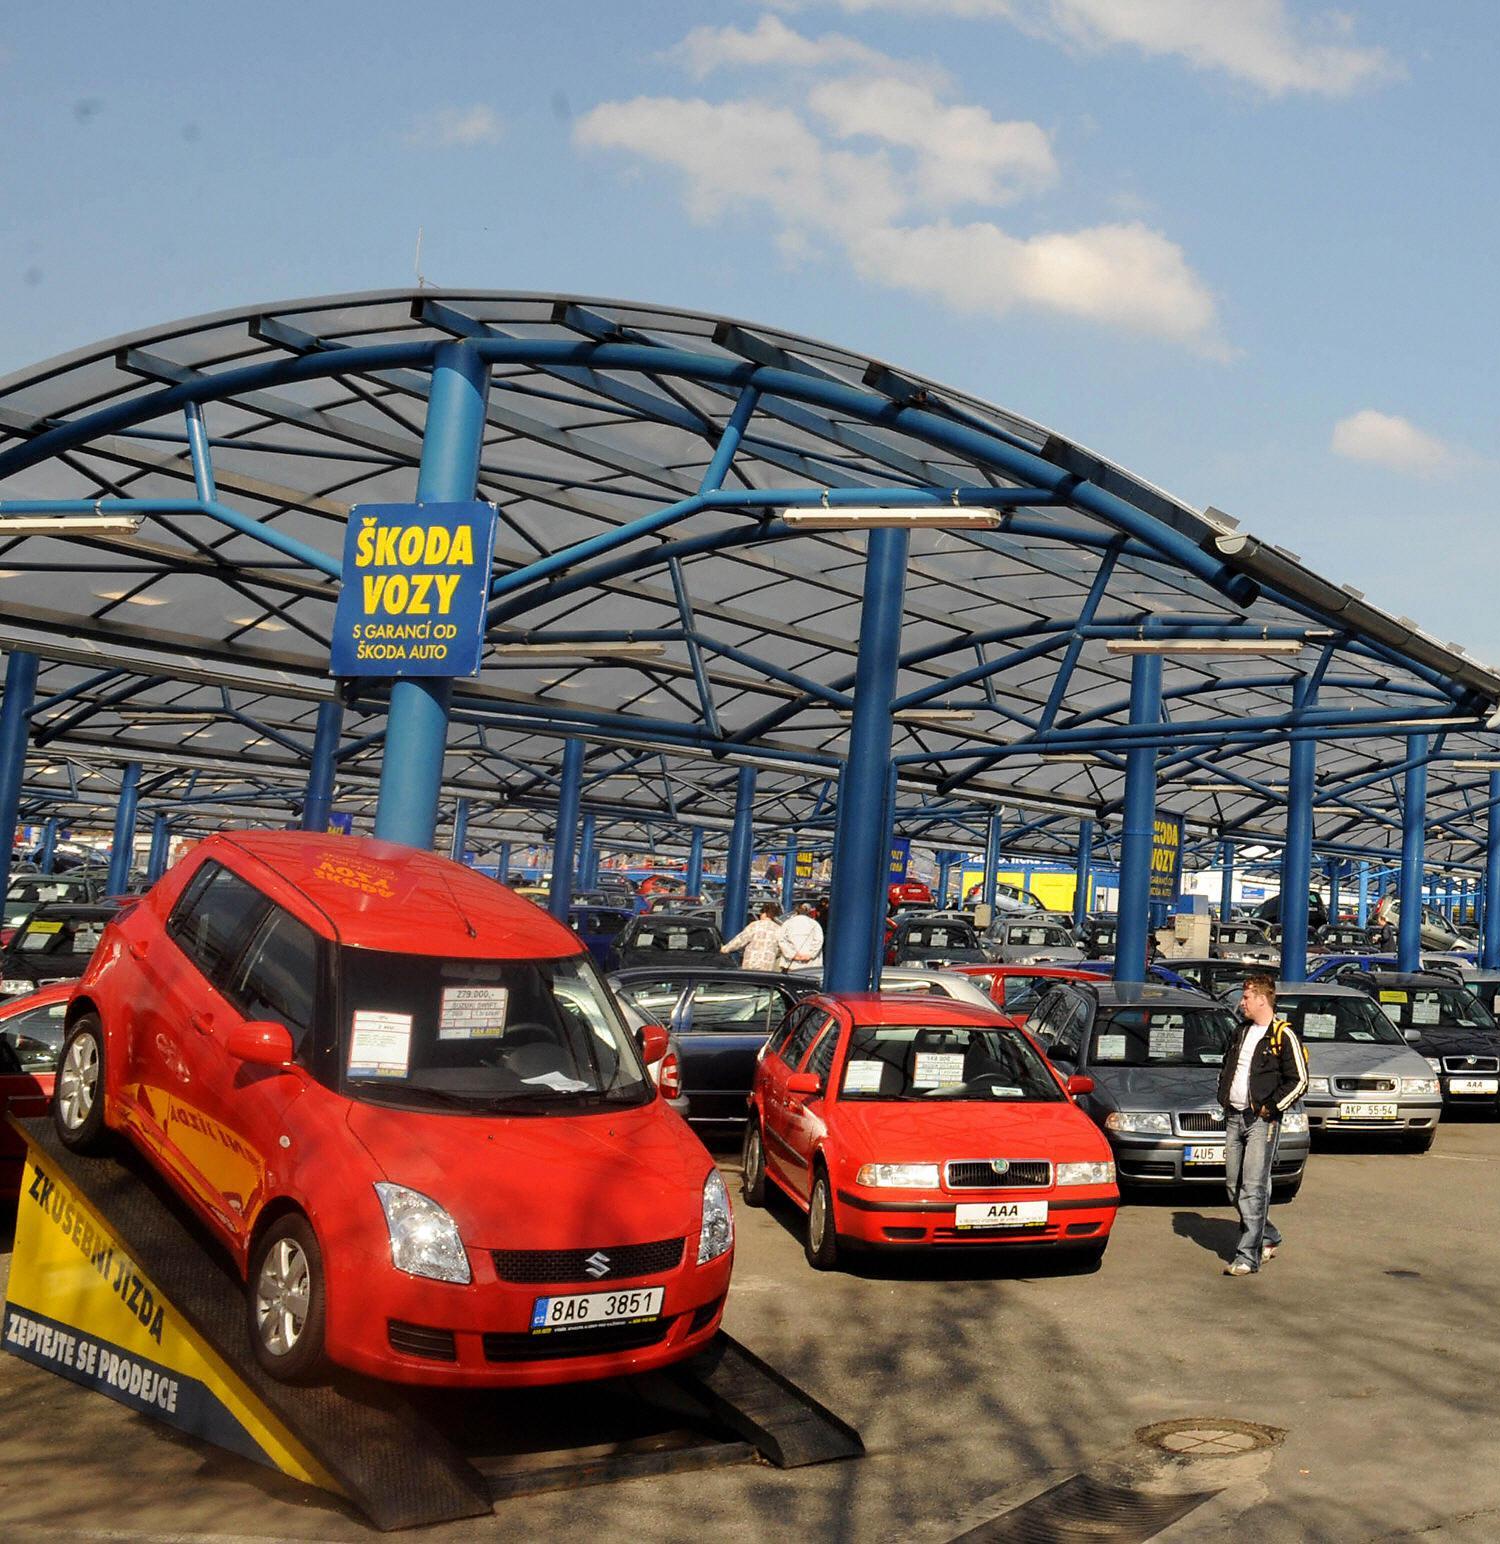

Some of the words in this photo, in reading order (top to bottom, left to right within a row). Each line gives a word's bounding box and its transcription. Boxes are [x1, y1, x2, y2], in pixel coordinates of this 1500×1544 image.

[356, 517, 474, 567] ŠKODA
[363, 574, 461, 615] VOZY
[352, 624, 362, 639] S
[364, 621, 432, 639] GARANCÍ
[433, 624, 457, 639] OD
[357, 640, 406, 660] ŠKODA
[409, 645, 447, 660] AUTO
[1346, 1106, 1362, 1114] AKP
[1368, 1106, 1393, 1114] 55-54
[1193, 1148, 1214, 1160] 4U5
[987, 1205, 1018, 1217] AAA
[552, 1298, 590, 1321] 8A6
[604, 1292, 652, 1316] 3851
[7, 1313, 76, 1366] ZEPTEJTE
[76, 1340, 98, 1374] SE
[98, 1349, 179, 1414] PRODEJCE
